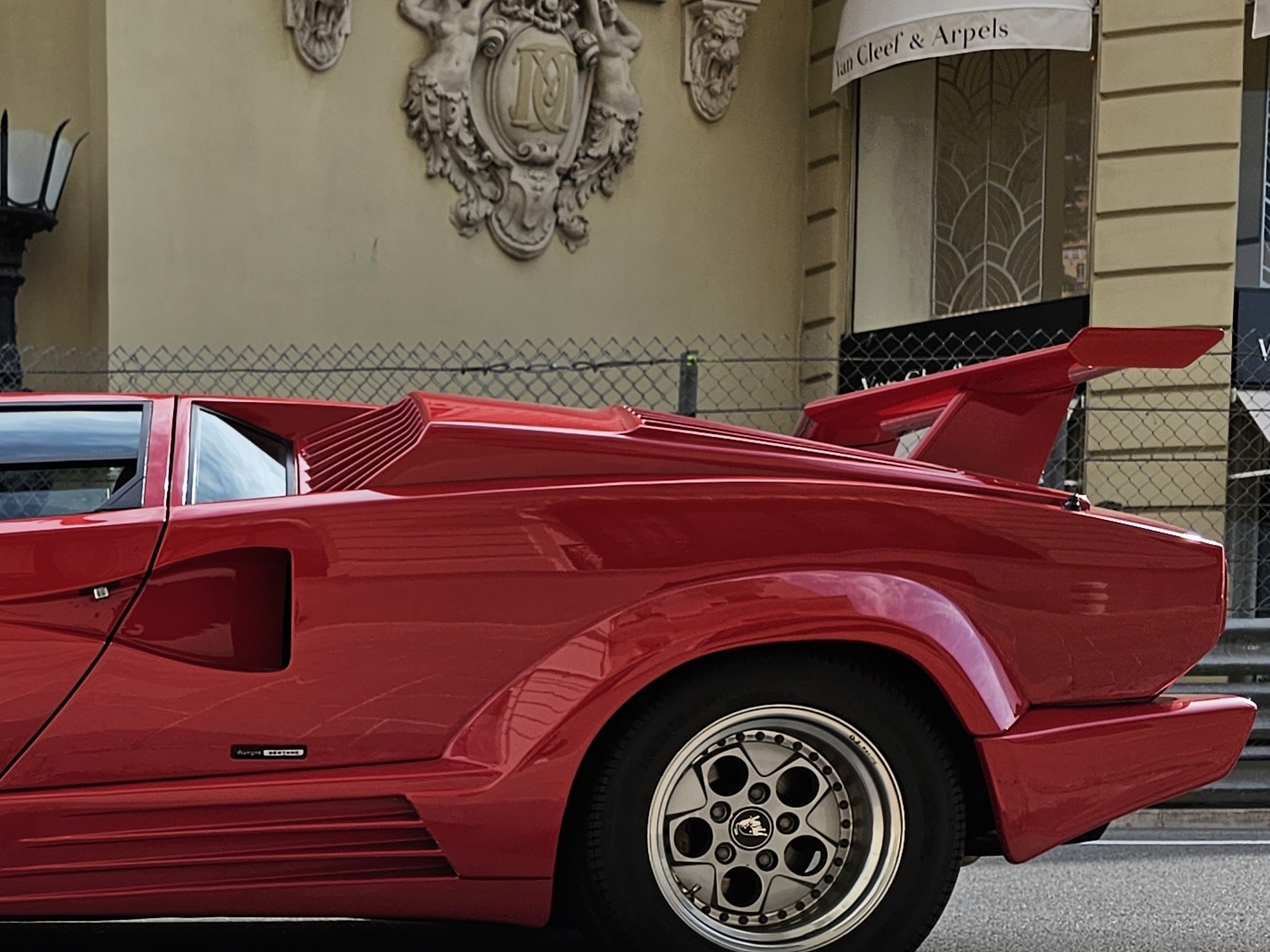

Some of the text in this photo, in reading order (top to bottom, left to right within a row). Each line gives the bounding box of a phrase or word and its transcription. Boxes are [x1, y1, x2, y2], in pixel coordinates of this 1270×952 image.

[857, 32, 904, 66] Cleef
[909, 34, 925, 50] &
[931, 17, 1009, 49] Arpels
